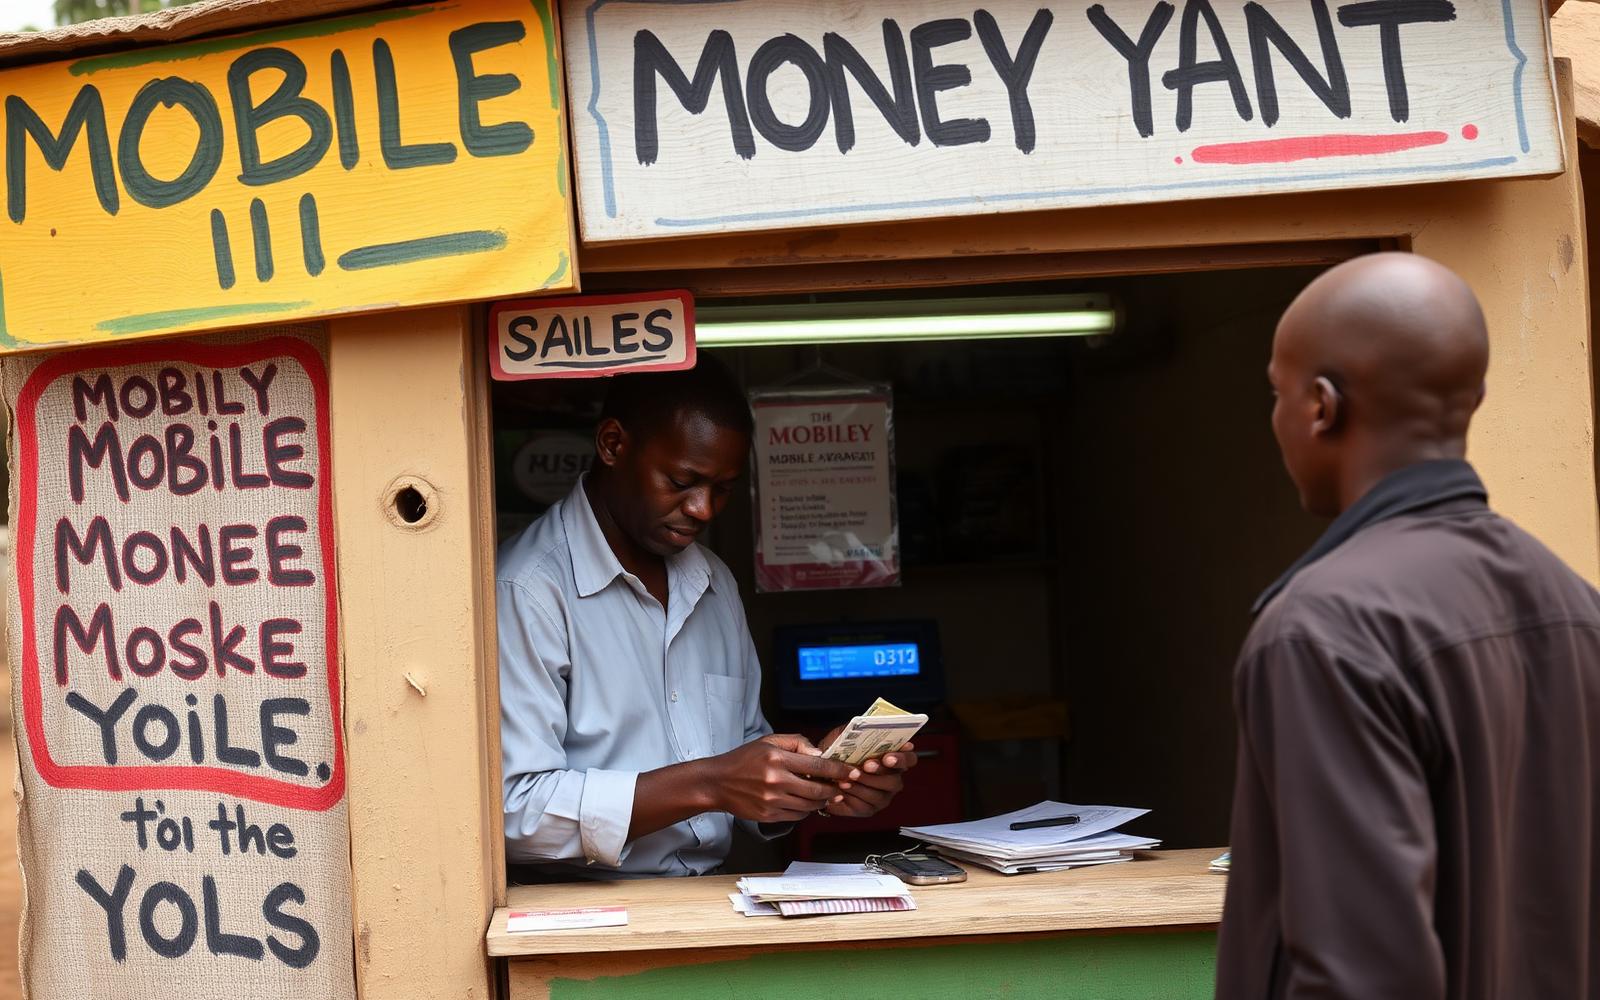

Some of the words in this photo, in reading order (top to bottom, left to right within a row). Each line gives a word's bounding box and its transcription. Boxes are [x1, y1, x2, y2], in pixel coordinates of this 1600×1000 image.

[634, 8, 1054, 166] MONEY
[1086, 0, 1457, 138] YANT
[5, 20, 535, 224] MOBILE
[504, 309, 674, 361] SAILES
[72, 364, 278, 422] MOBILY
[768, 423, 874, 445] MOBILEY
[54, 515, 316, 595] MONEE
[208, 802, 298, 859] the
[75, 863, 321, 968] YOLS
